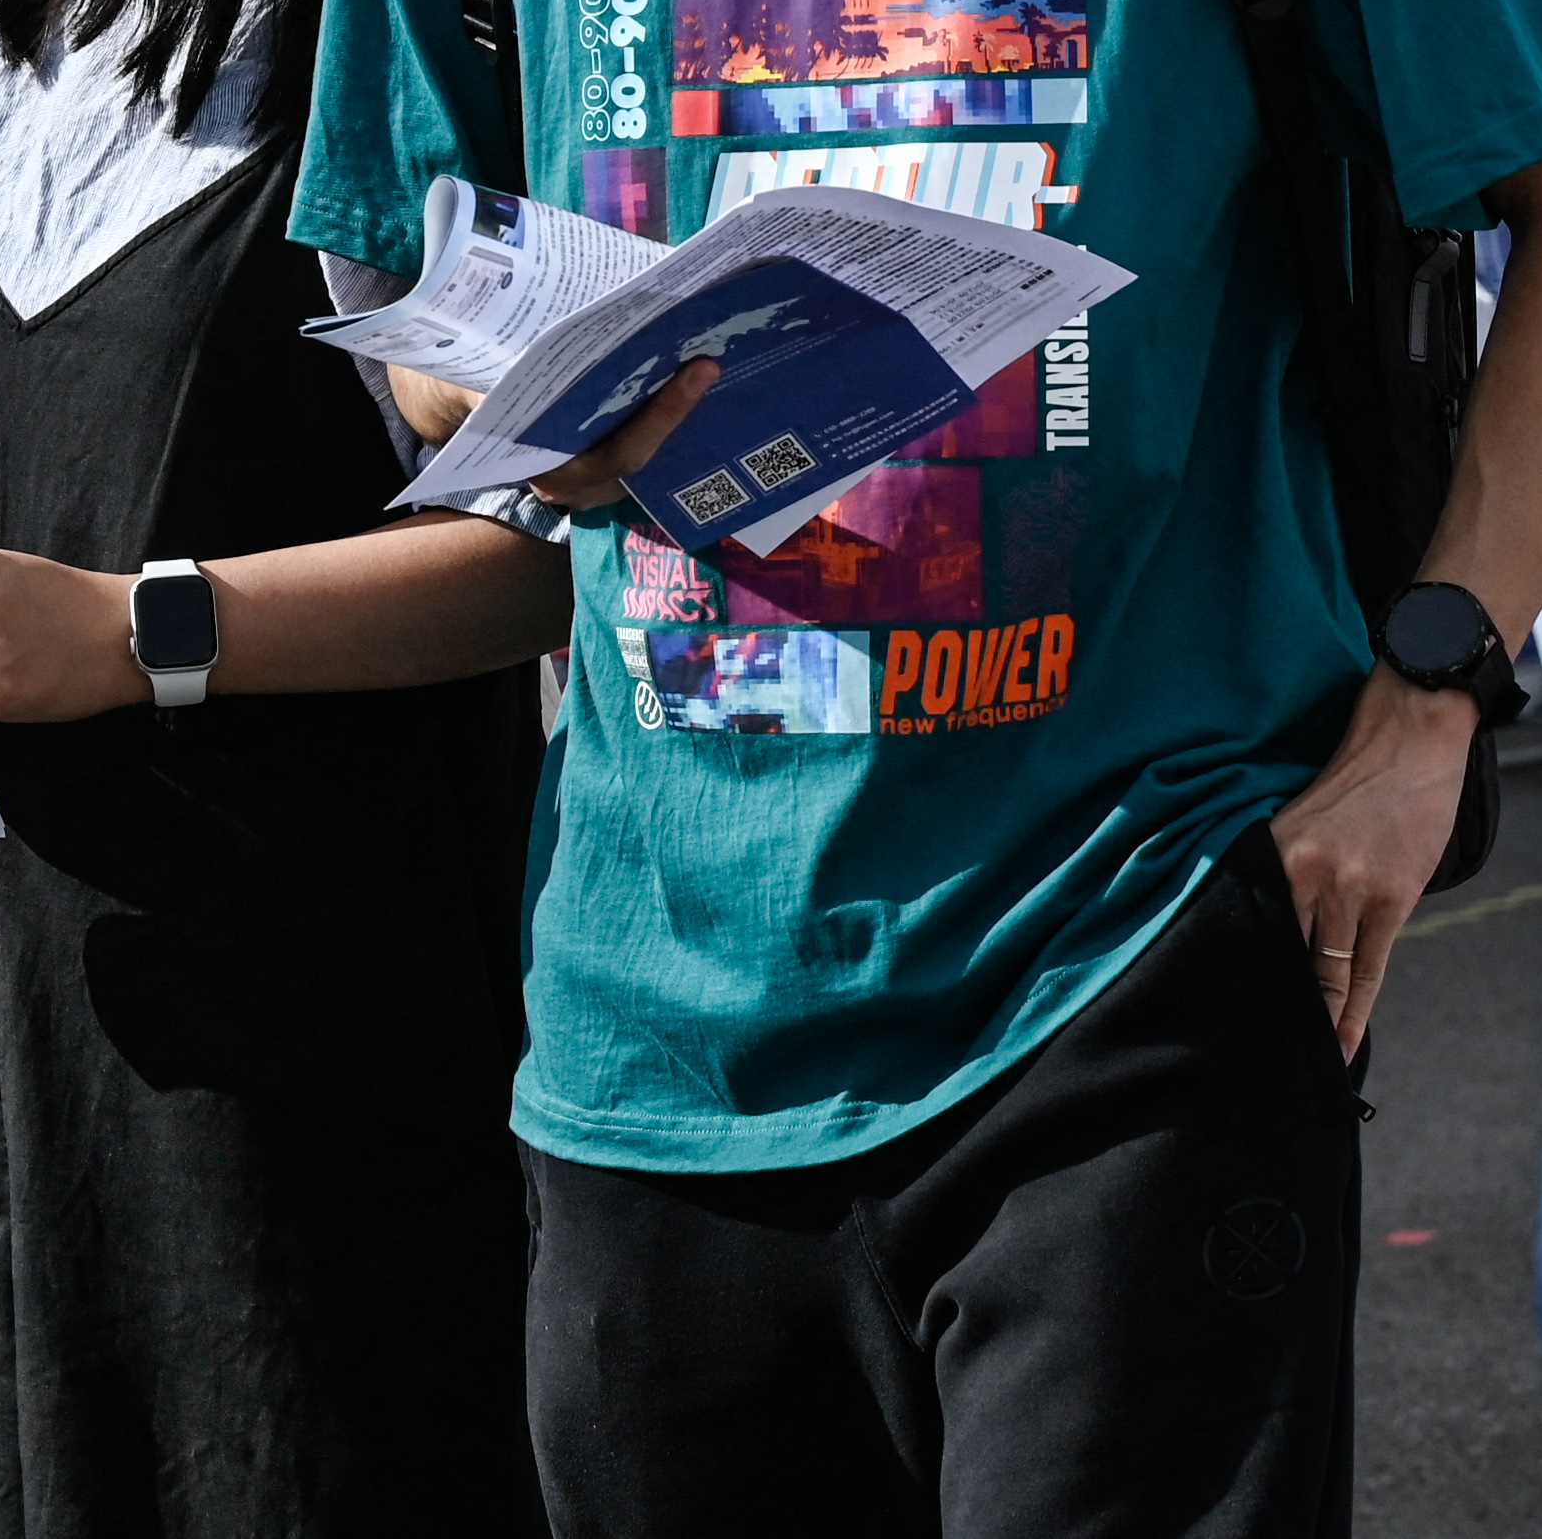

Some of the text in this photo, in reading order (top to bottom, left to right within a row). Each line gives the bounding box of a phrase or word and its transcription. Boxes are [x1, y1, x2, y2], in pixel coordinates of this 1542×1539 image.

[627, 555, 711, 590] VISUAL
[623, 586, 716, 623] IMPACT
[879, 613, 1075, 715] POWER
[879, 717, 935, 735] new
